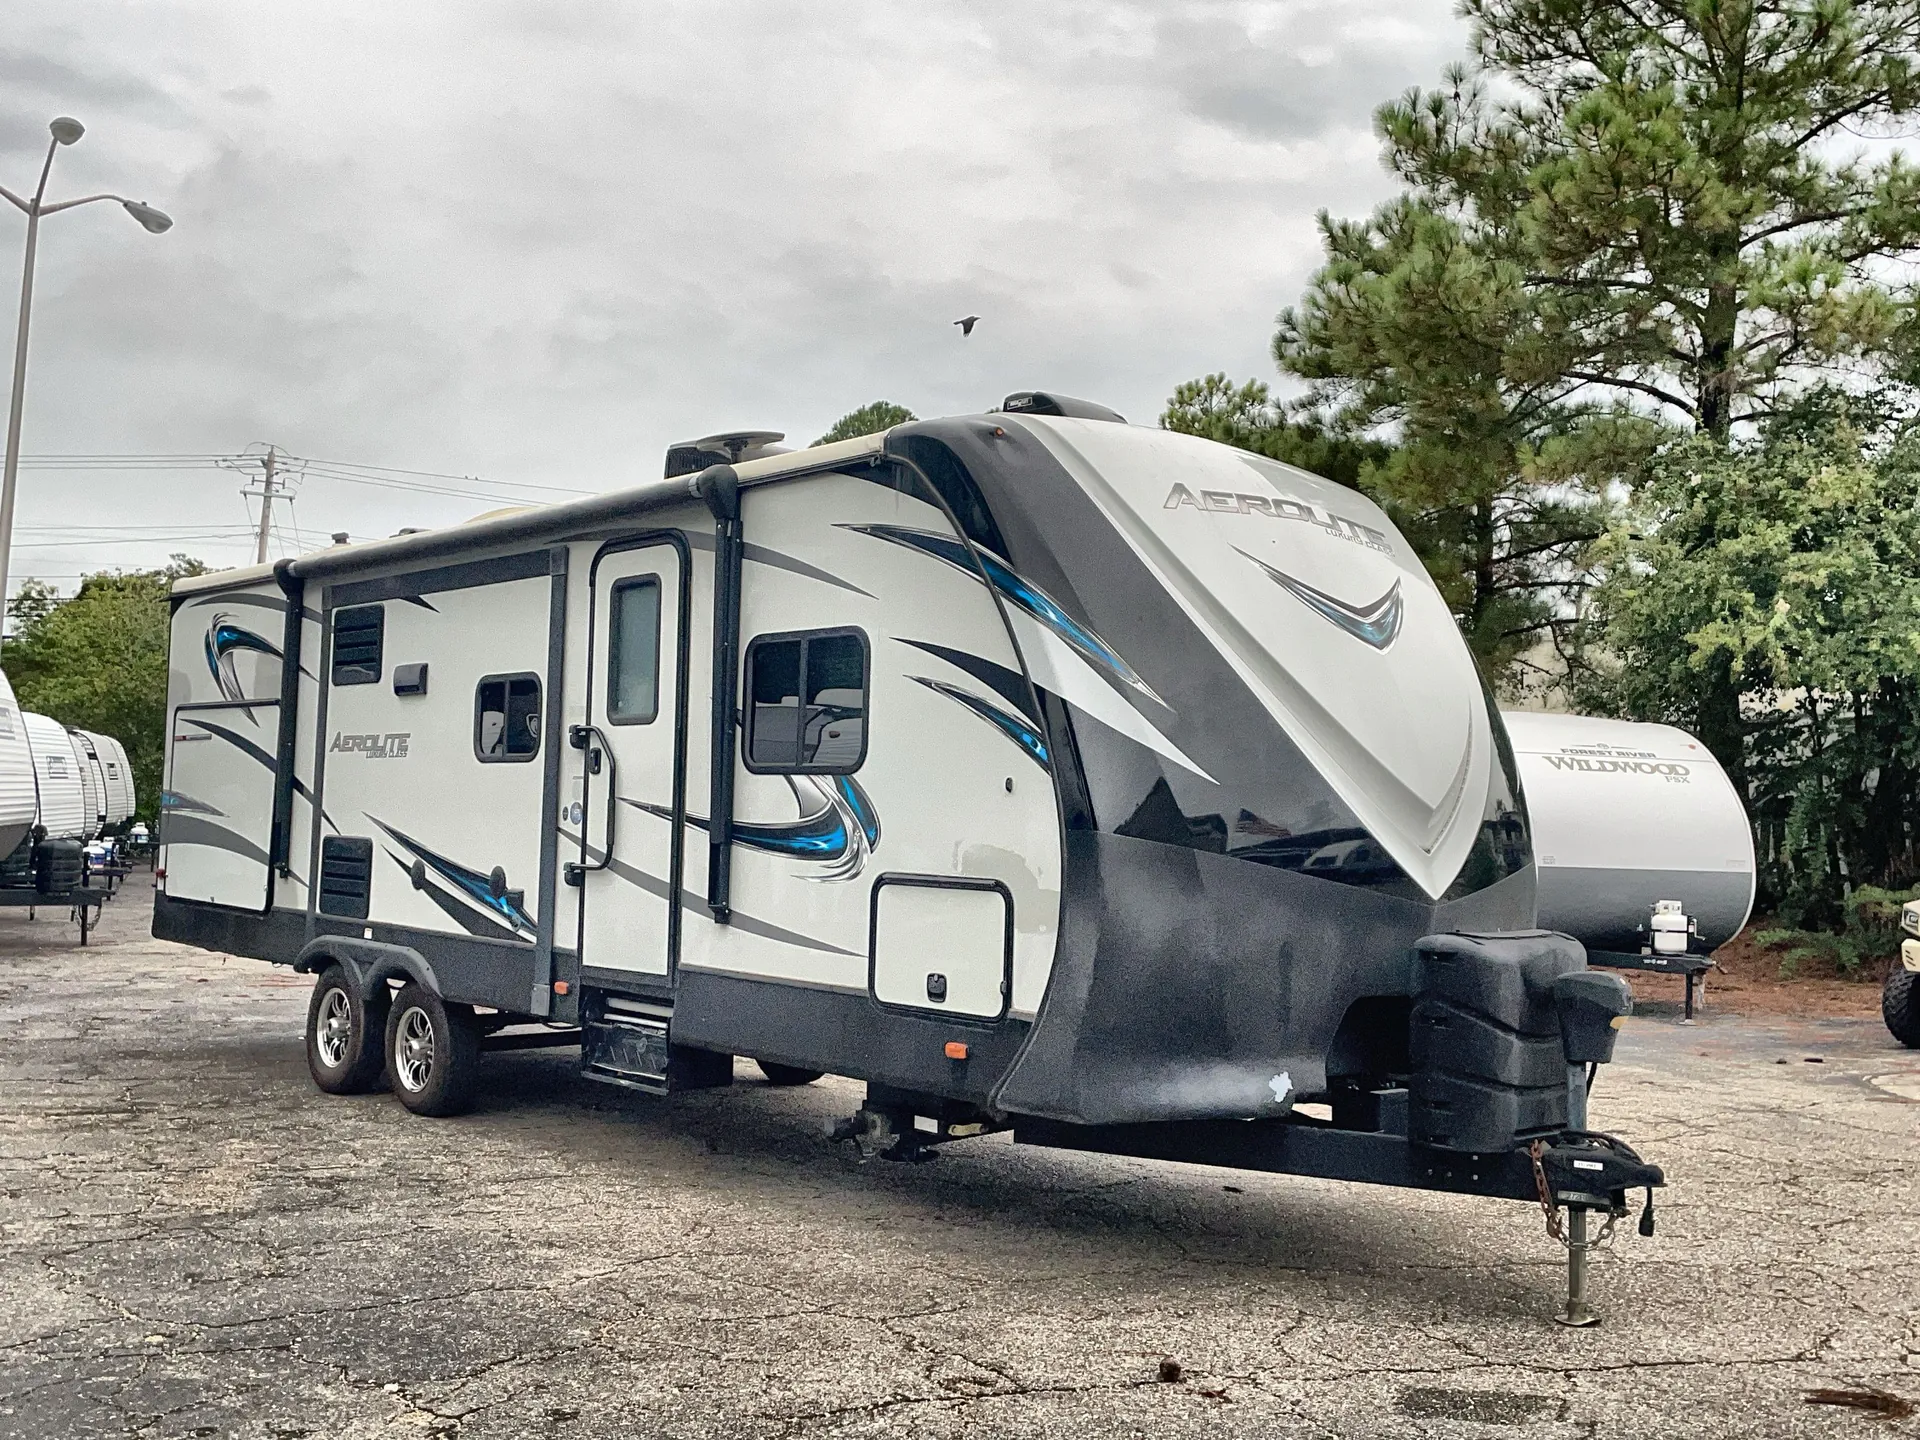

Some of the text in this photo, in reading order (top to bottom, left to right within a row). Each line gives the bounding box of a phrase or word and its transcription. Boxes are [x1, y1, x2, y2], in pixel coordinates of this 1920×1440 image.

[1163, 482, 1392, 551] AEROLITE
[1325, 528, 1363, 545] LUXURY
[329, 731, 411, 752] AEROLITE
[1560, 748, 1657, 758] FOREST RIVER
[1542, 756, 1690, 776] WILDWOOD
[1665, 775, 1690, 784] FSX
